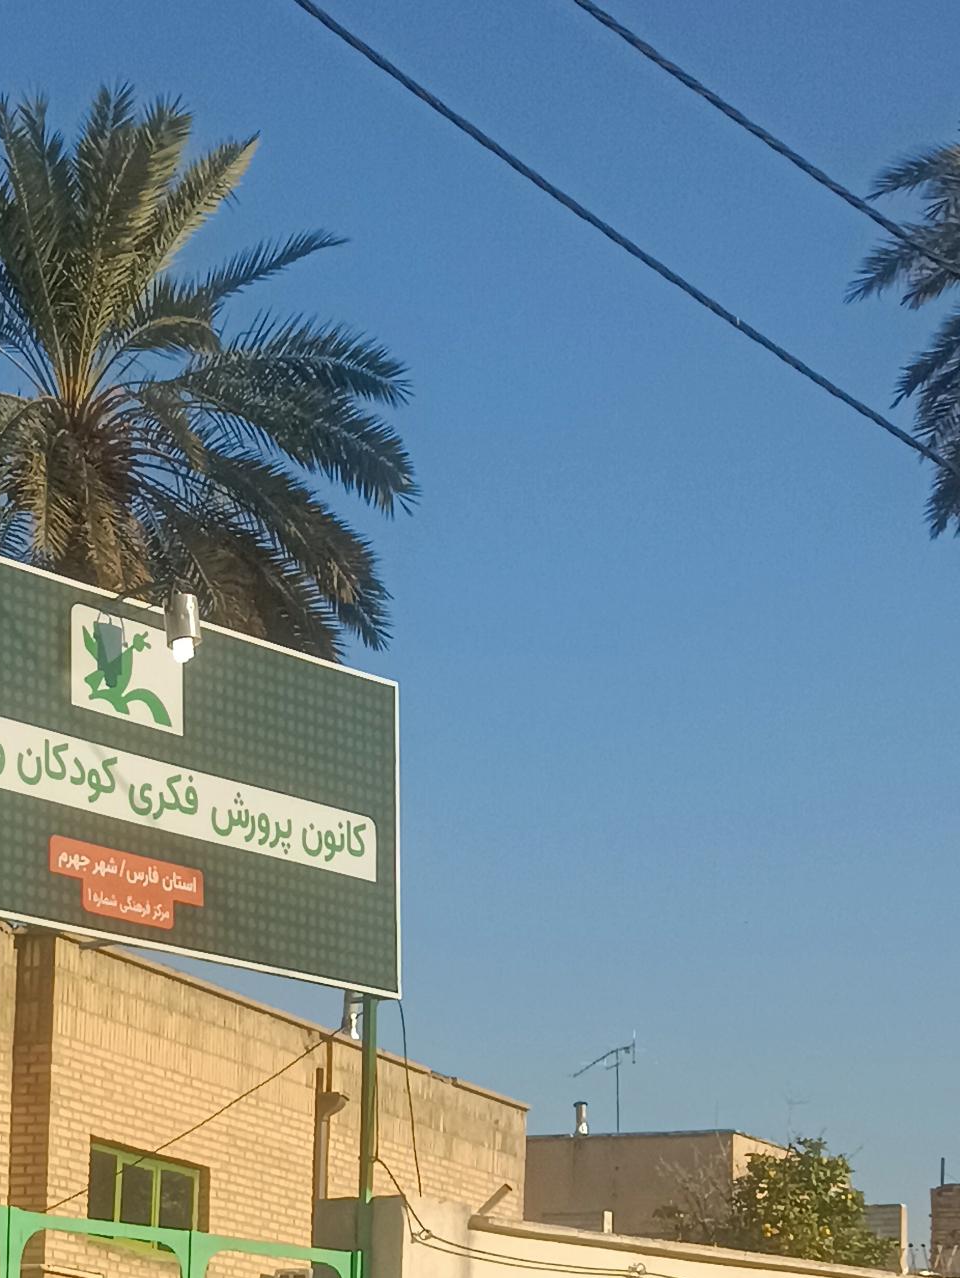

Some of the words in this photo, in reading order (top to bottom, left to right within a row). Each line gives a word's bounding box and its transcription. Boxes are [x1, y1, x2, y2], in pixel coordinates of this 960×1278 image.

[17, 739, 118, 803] کودکان
[128, 774, 198, 819] فکری
[211, 792, 292, 855] پرورش
[302, 818, 366, 862] کانون
[58, 851, 90, 872] جهرم
[92, 857, 117, 877] شهر
[126, 866, 159, 886] فارس
[162, 872, 196, 893] استان
[119, 896, 150, 918] فرهنگی
[152, 904, 169, 922] مرکز
